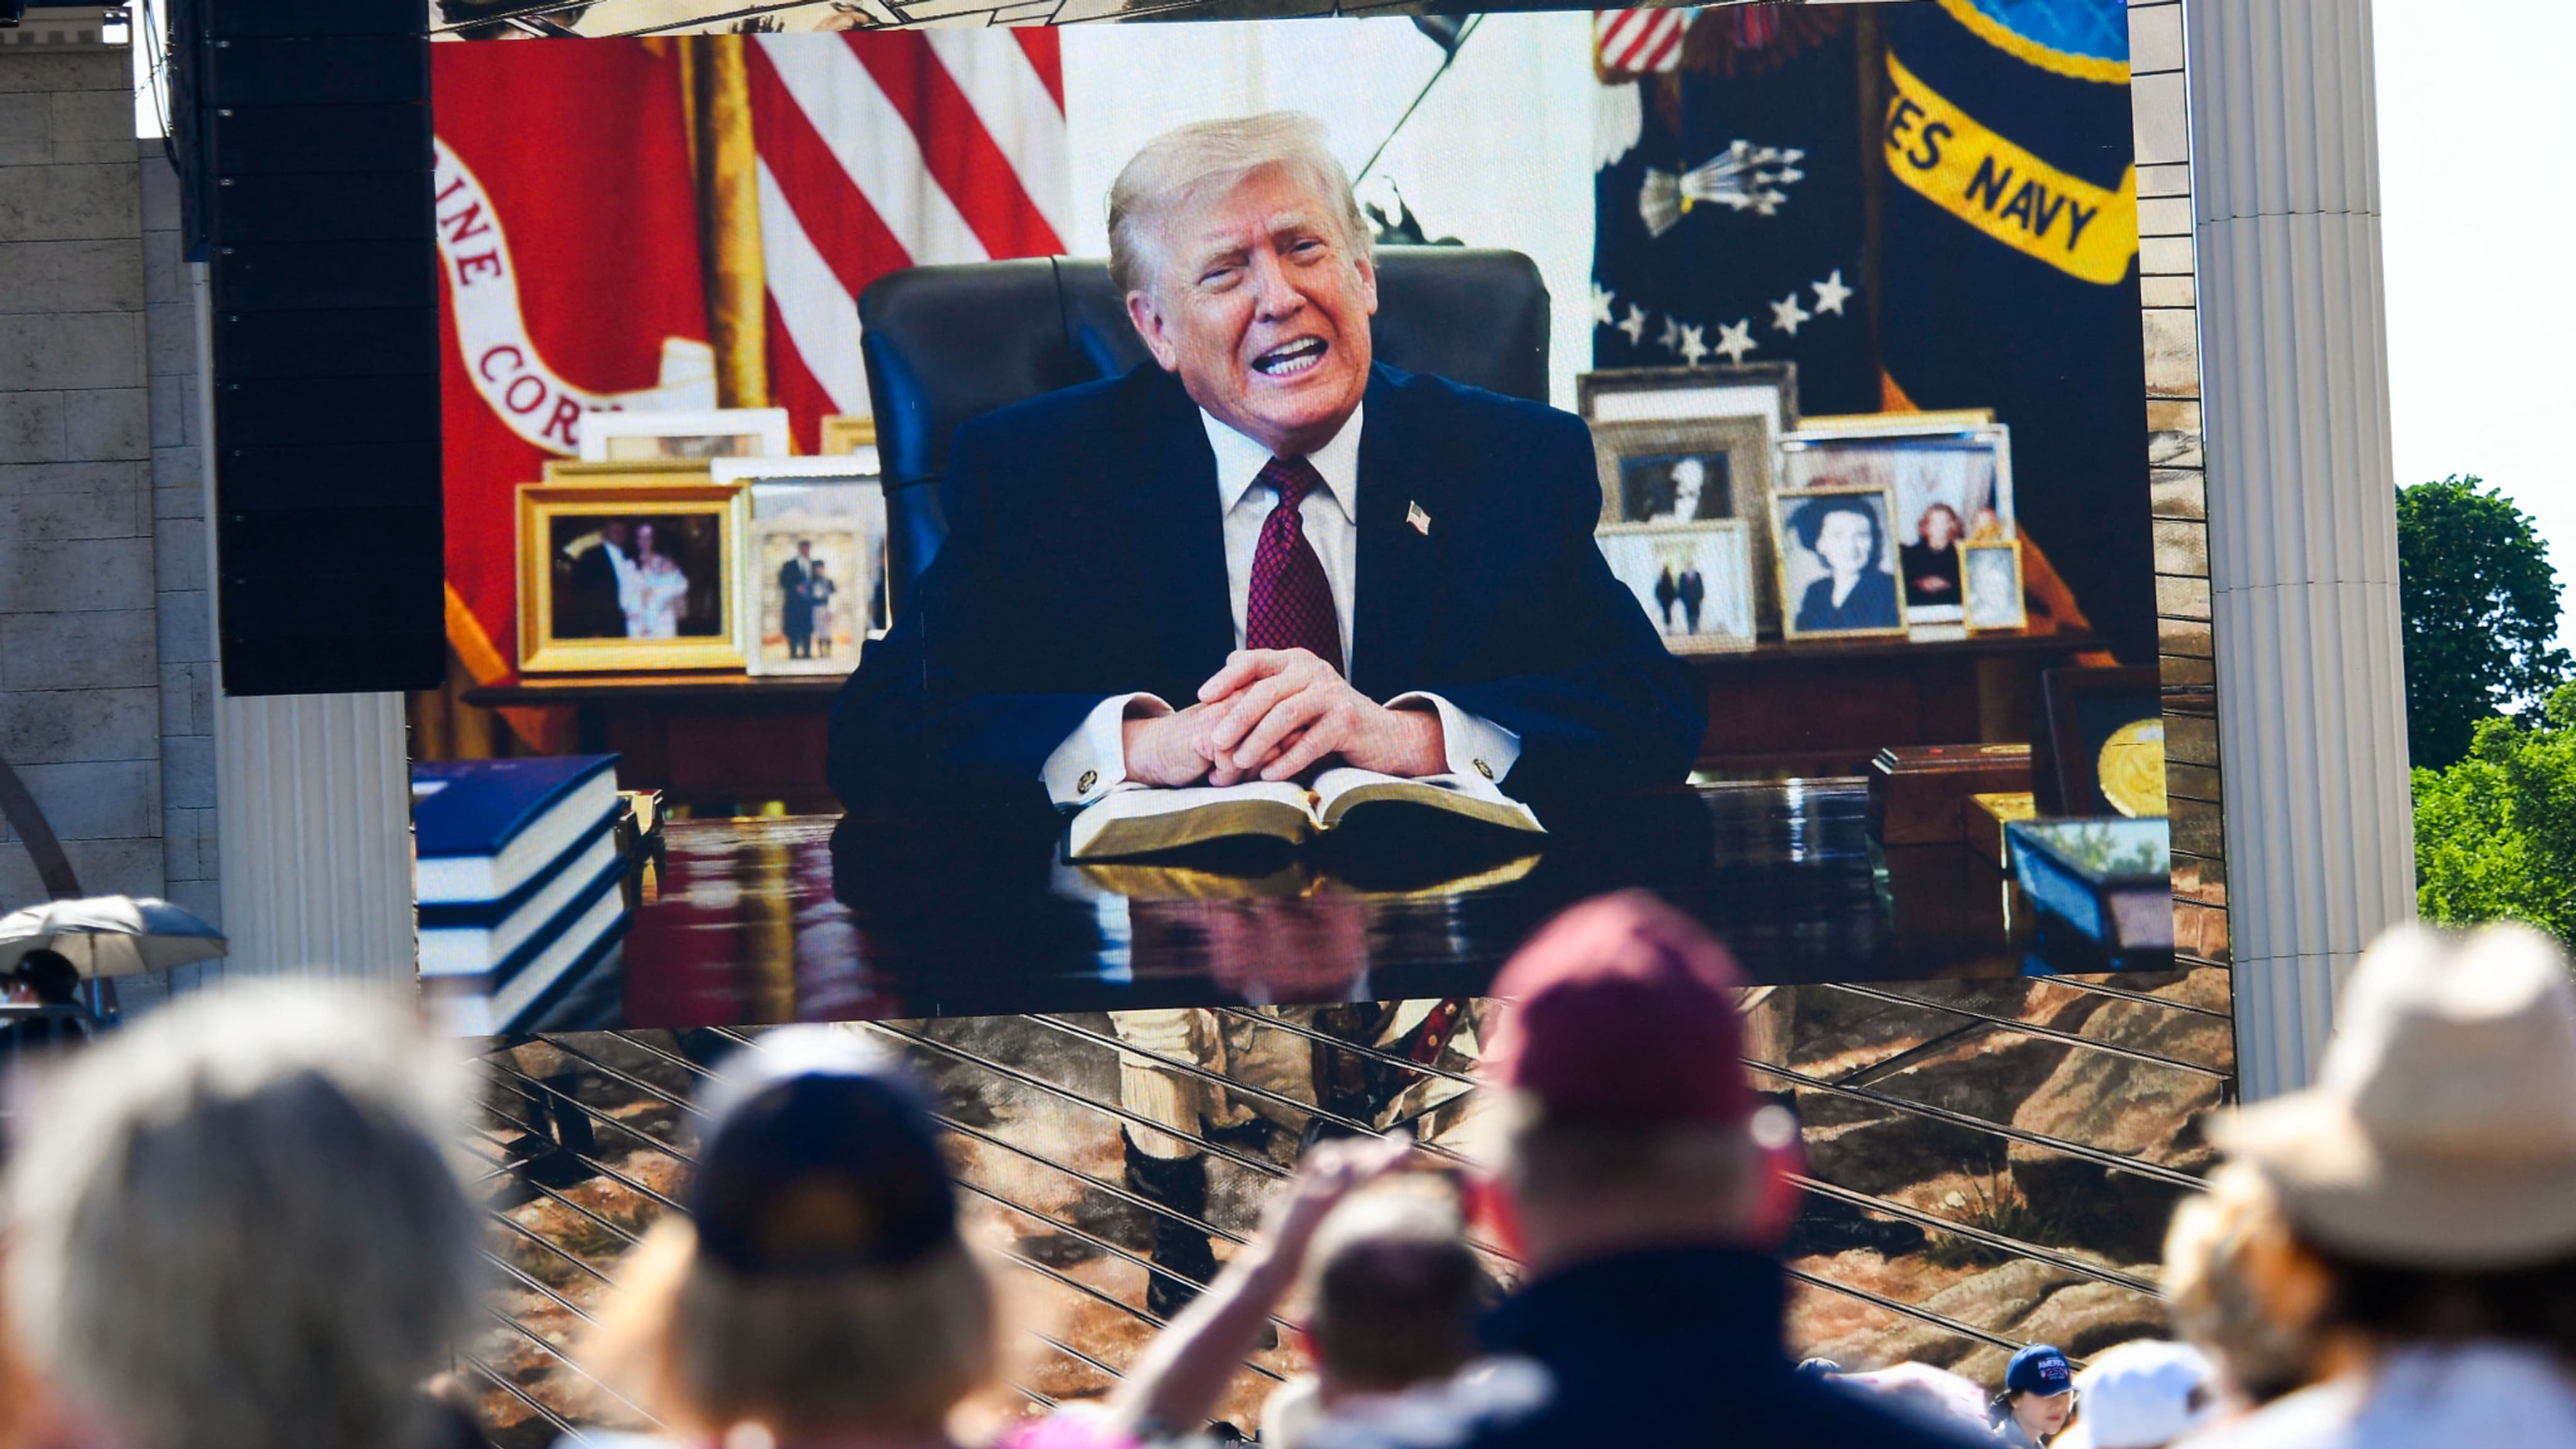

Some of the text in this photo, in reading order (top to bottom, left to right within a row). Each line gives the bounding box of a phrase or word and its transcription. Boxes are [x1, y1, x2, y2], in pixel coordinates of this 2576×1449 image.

[434, 152, 624, 447] INE COR
[1965, 154, 2097, 252] NAVY
